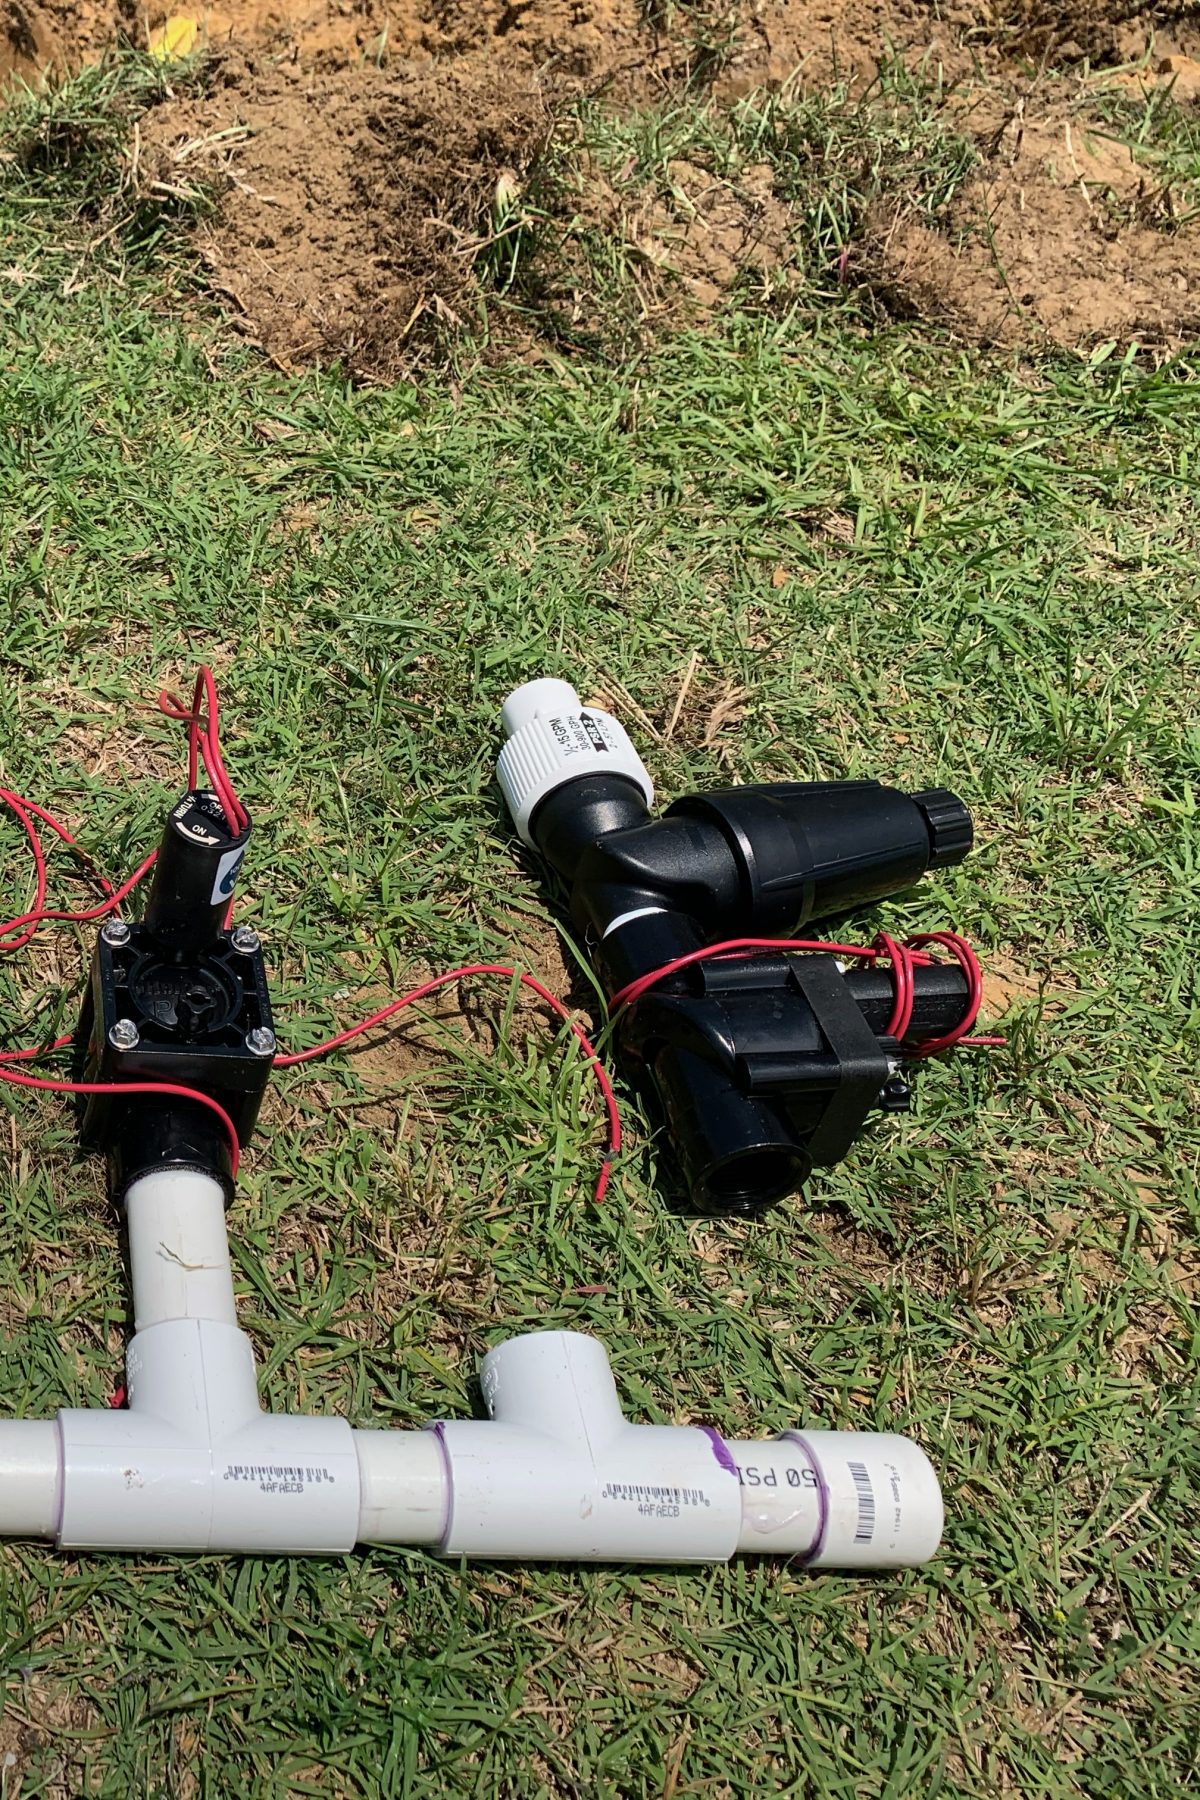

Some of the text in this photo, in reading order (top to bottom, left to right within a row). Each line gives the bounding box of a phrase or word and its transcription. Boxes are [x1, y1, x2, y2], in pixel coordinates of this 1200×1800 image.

[173, 801, 194, 819] TURN
[191, 824, 208, 836] ON
[735, 1466, 778, 1487] PSI
